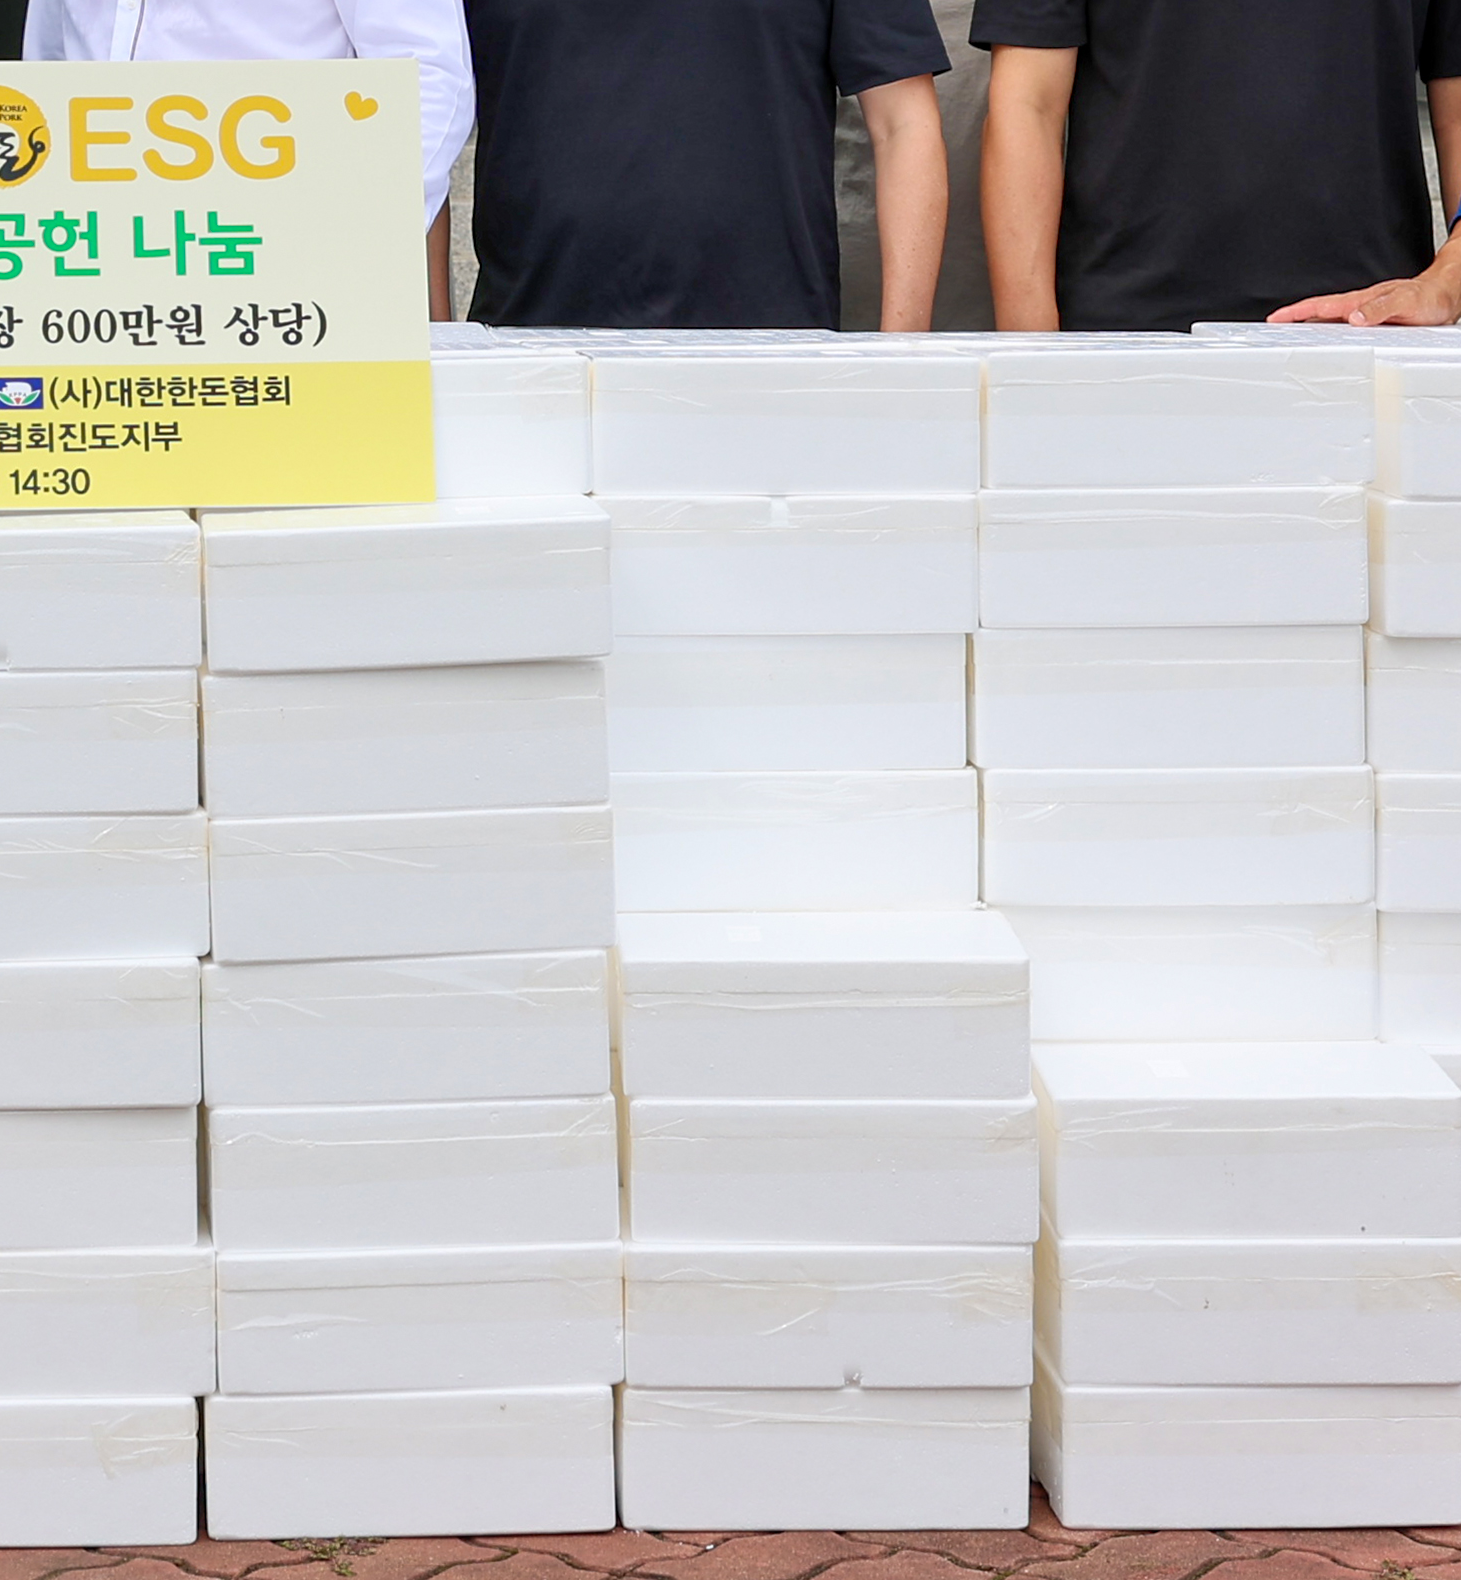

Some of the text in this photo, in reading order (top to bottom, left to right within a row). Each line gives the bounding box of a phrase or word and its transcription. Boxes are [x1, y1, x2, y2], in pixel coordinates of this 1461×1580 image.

[69, 95, 297, 183] ESG
[133, 209, 263, 276] 나눔
[41, 303, 207, 347] 600만원
[224, 301, 328, 348] 상당)
[49, 375, 291, 410] (사)대한한돈협회
[9, 468, 91, 496] 14:30
